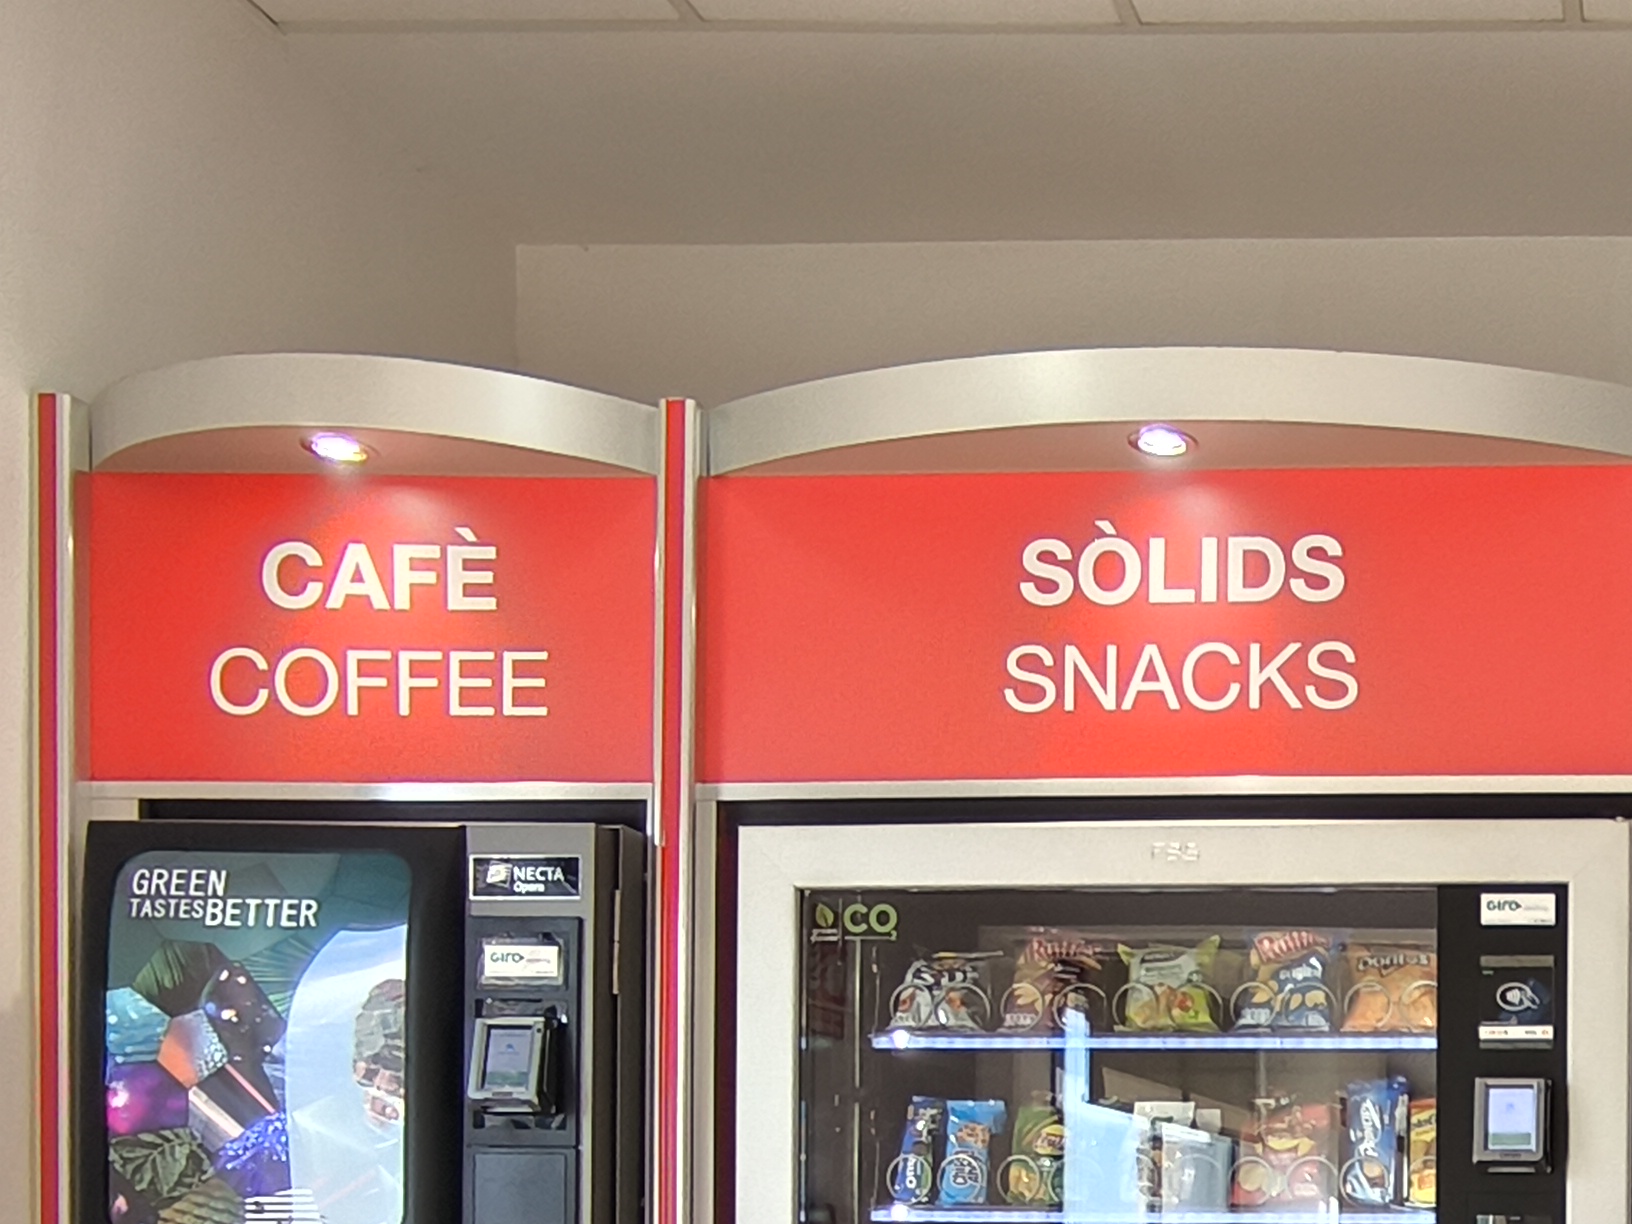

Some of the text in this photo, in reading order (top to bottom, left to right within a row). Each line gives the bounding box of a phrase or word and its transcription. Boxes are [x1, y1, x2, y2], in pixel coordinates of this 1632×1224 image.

[262, 528, 498, 611] CAFÈ
[1019, 520, 1345, 606] SÒLIDS
[210, 647, 549, 716] COFFEE
[1003, 641, 1359, 713] SNACKS
[132, 868, 227, 897] GREEN
[513, 866, 565, 881] NECTA
[130, 898, 318, 928] TASTES BETTER
